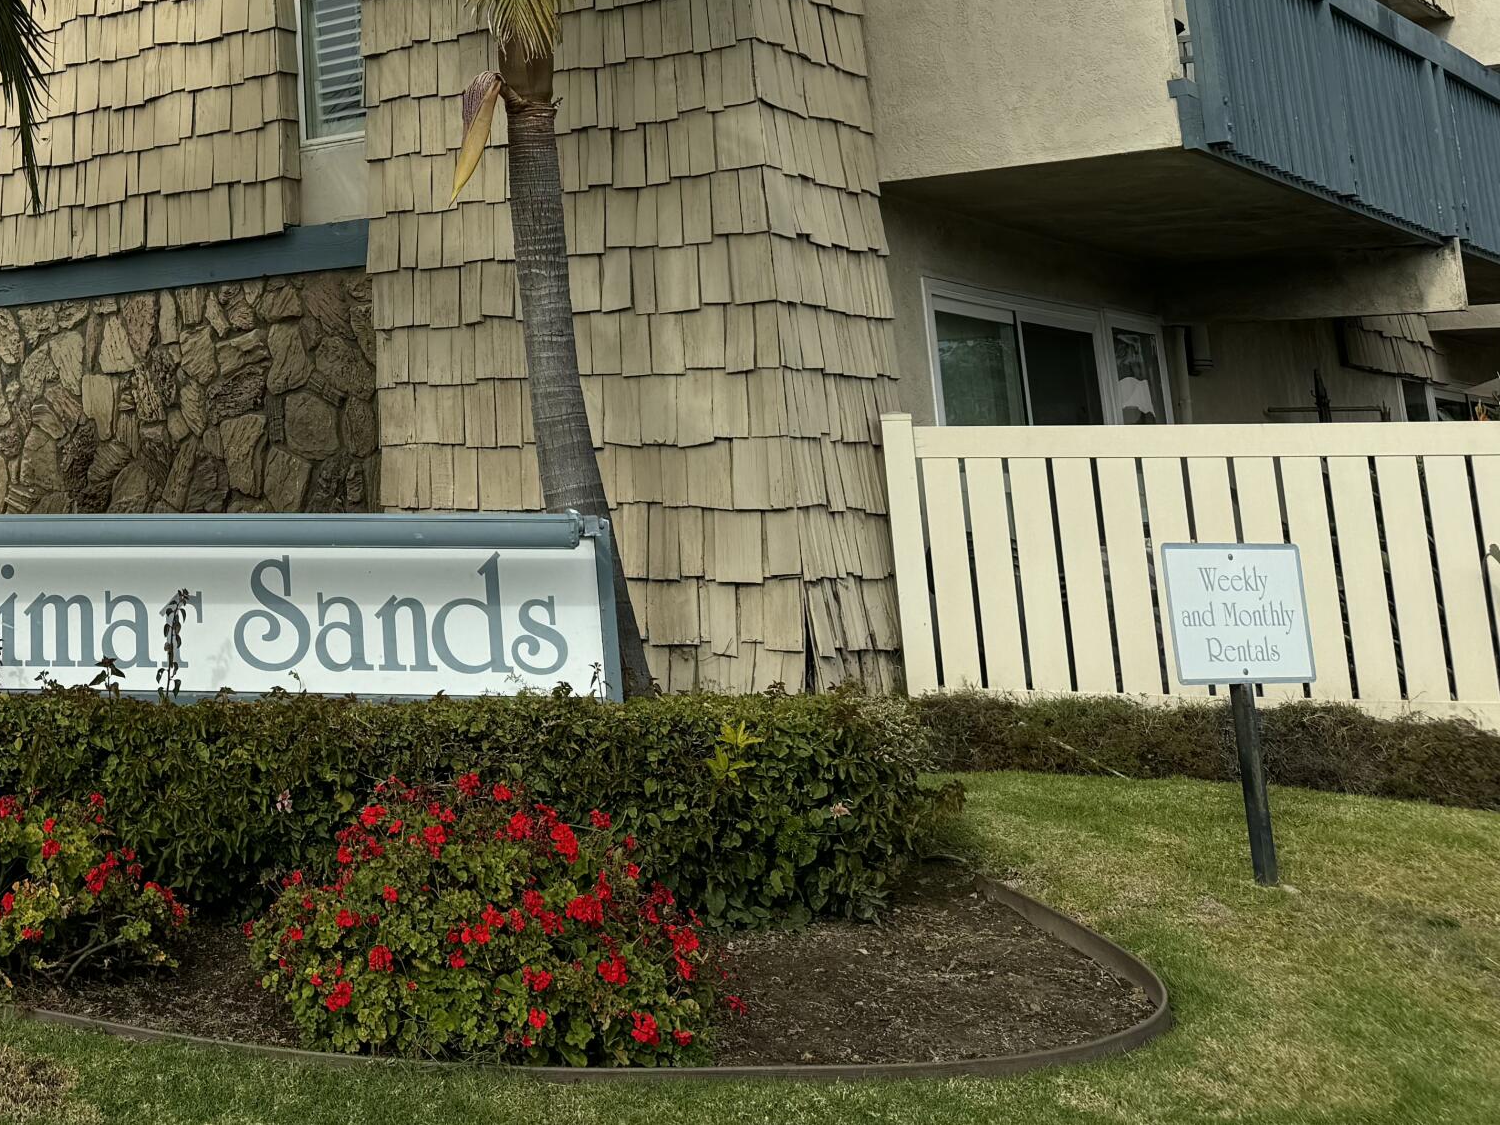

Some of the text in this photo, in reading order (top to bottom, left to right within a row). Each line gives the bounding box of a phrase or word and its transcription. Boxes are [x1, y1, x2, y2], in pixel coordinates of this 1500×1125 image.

[1197, 565, 1268, 601] Weekly
[233, 550, 569, 675] Sands
[1181, 600, 1296, 635] and Monthly
[1205, 635, 1281, 663] Rentals
